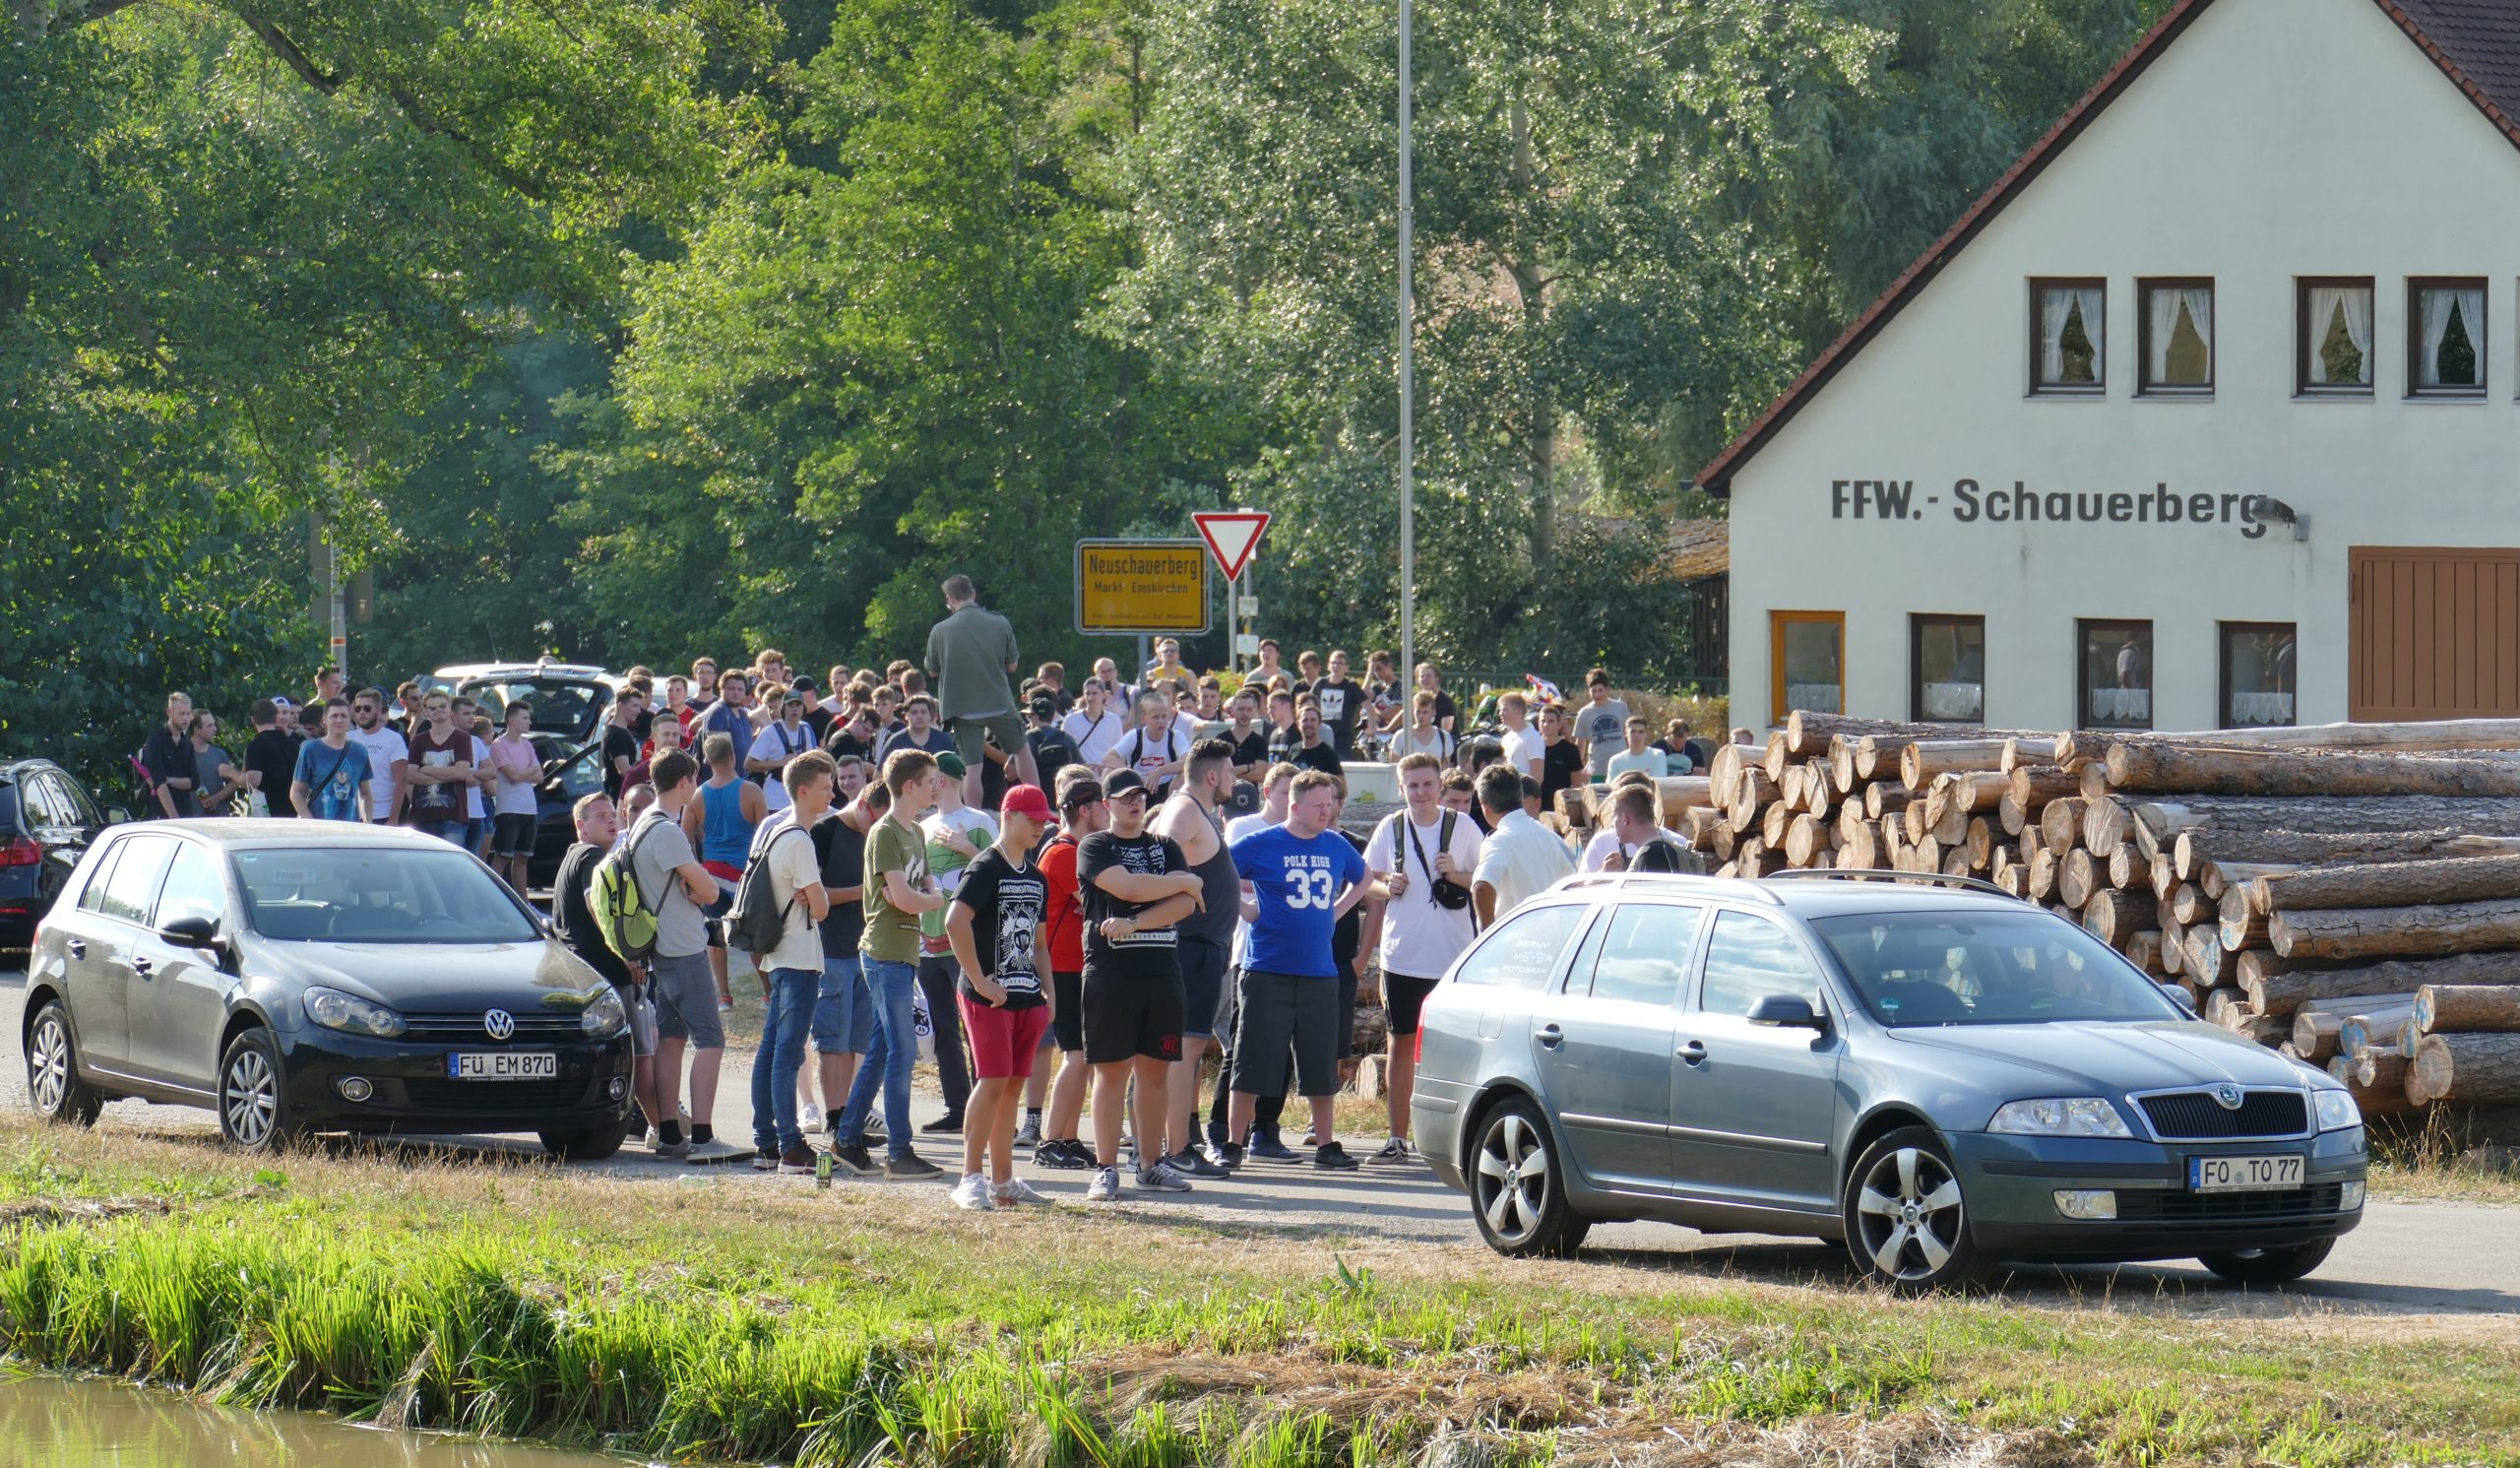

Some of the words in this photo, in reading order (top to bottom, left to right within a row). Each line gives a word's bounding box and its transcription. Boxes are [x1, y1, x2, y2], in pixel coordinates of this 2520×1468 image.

[1953, 478, 2269, 540] Schauerberg
[1089, 553, 1198, 581] Neuschauerberg
[1095, 581, 1123, 593] Markt
[1132, 581, 1189, 594] Emskirchen
[1283, 855, 1307, 867] POLK
[1310, 855, 1331, 867] HIGH
[1285, 868, 1334, 911] 33
[1515, 939, 1551, 949] BERNY
[1513, 951, 1554, 964] MEYER
[460, 1055, 484, 1074] FÜ
[495, 1055, 519, 1074] EM
[522, 1055, 554, 1074] 870
[2204, 1160, 2230, 1184] FO
[2248, 1159, 2272, 1182] TO
[2278, 1158, 2300, 1181] 77
